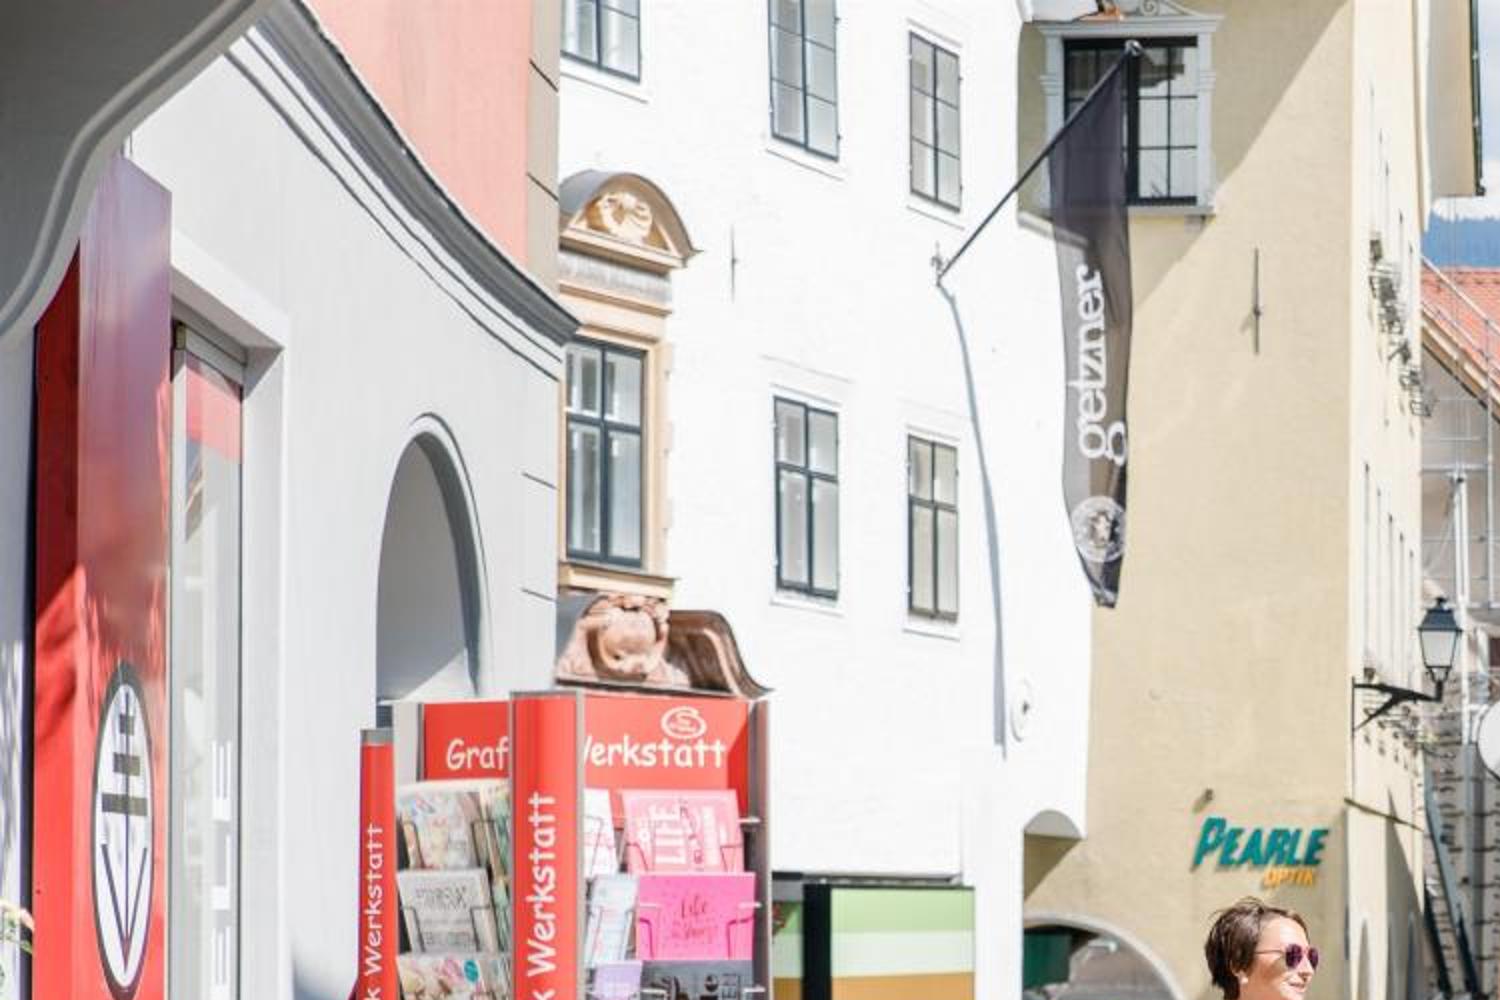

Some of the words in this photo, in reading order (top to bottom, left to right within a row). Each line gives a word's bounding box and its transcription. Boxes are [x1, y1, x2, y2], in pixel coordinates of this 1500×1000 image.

[446, 735, 509, 770] Graf
[583, 733, 726, 768] erkstatt
[526, 790, 557, 978] Werkstatt
[1191, 815, 1330, 867] PEARLE
[362, 823, 384, 977] Werkstatt
